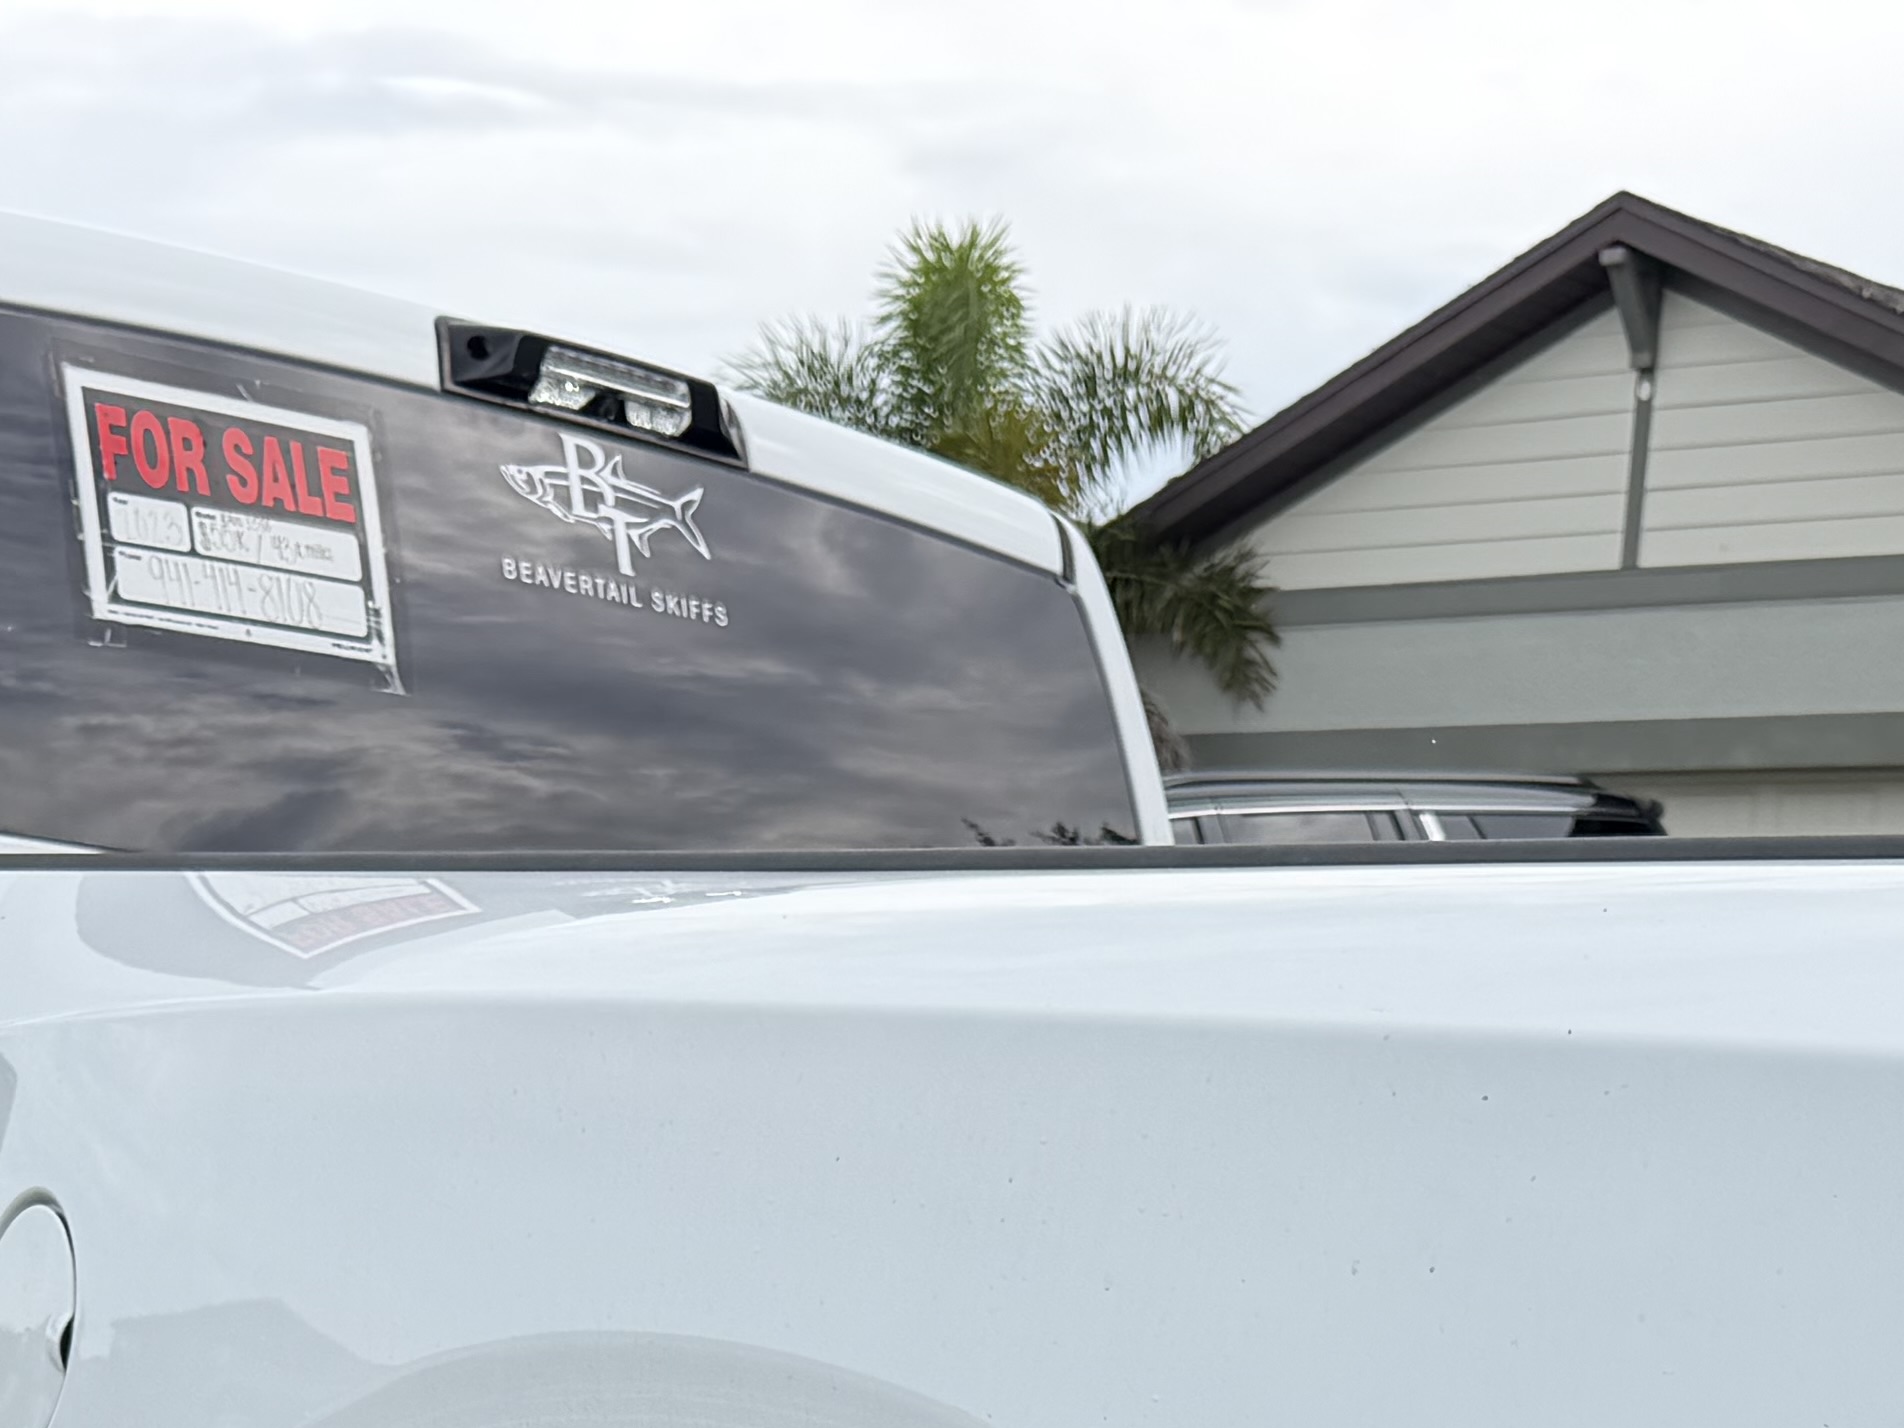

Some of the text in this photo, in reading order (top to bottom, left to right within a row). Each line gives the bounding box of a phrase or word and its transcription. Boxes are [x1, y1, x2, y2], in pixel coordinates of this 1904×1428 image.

[94, 402, 356, 524] FOR SALE
[501, 556, 729, 628] BEAVERTAIL SKIFFS
